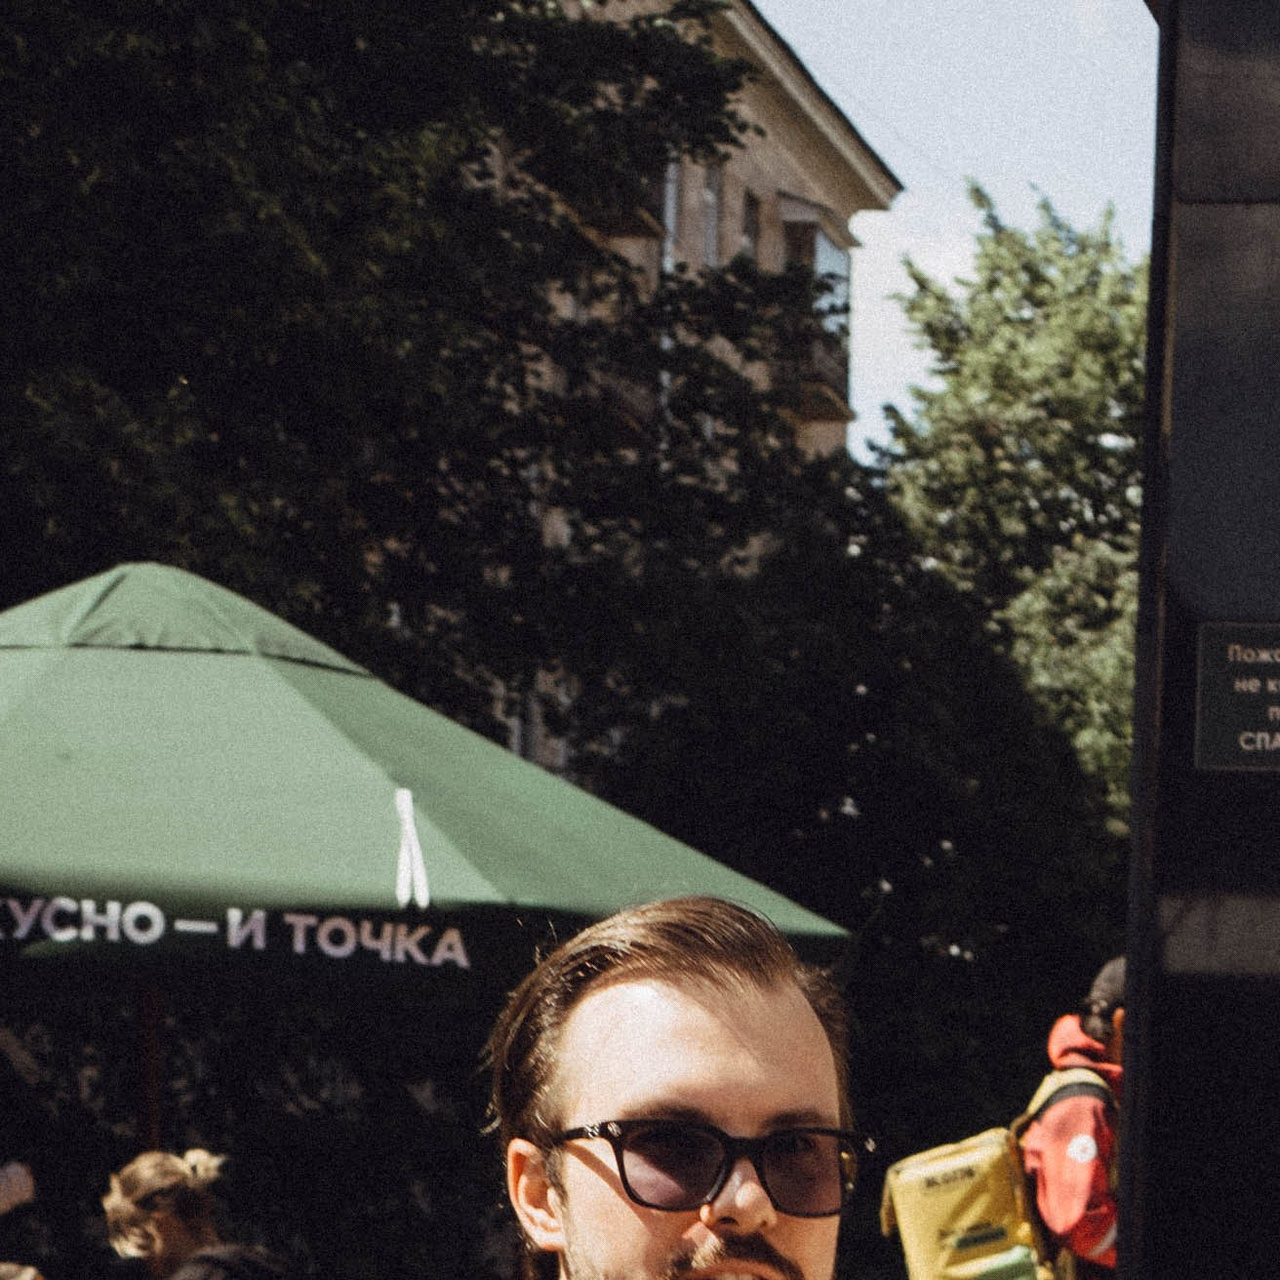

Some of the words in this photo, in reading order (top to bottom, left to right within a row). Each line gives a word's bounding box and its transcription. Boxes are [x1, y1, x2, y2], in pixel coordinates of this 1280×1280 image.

[1233, 678, 1261, 693] не
[0, 897, 165, 944] УСНО
[284, 913, 468, 967] ТОЧКА
